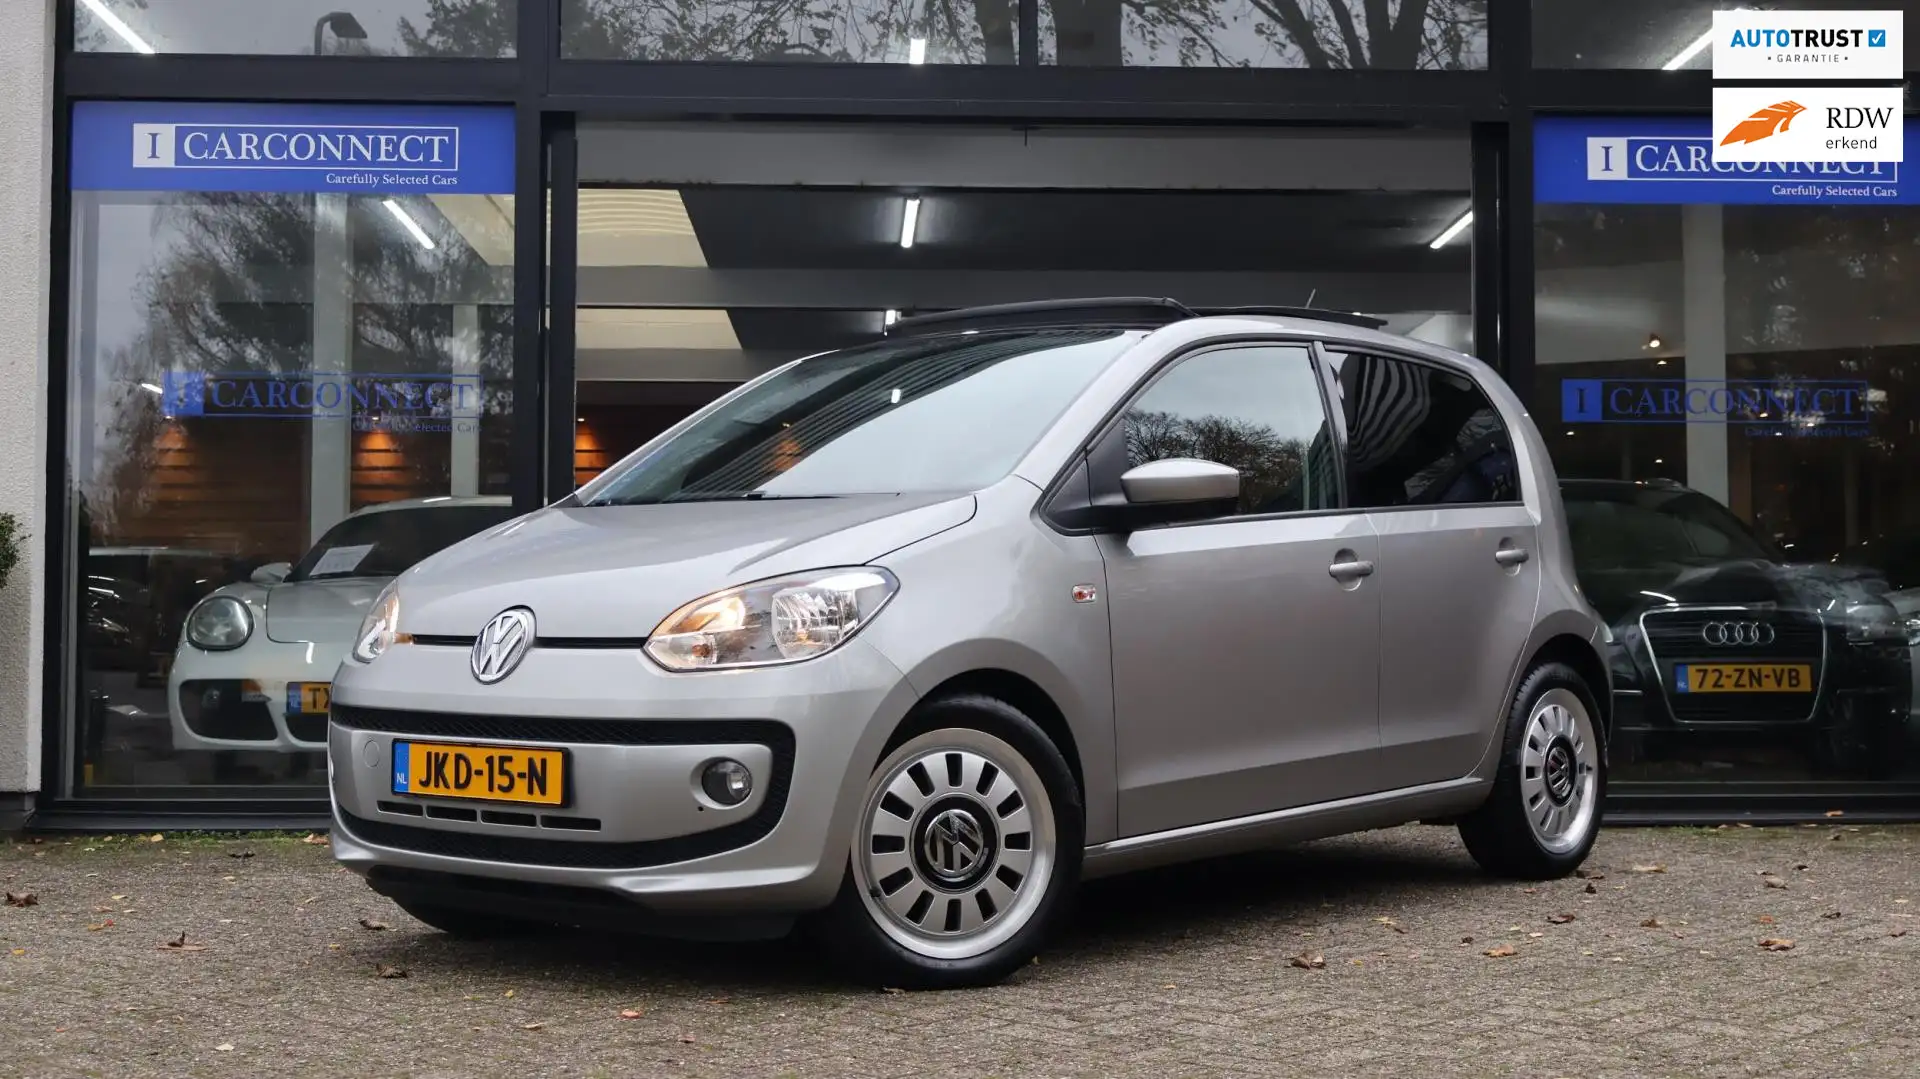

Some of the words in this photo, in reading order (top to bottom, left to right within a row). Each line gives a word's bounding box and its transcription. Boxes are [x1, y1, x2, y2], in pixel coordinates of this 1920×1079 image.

[184, 132, 449, 163] CARCONNECT
[326, 173, 379, 188] Carefully
[383, 174, 429, 185] Selected
[432, 175, 458, 185] Cars
[1772, 185, 1823, 199] Carefully
[1826, 186, 1870, 197] Selected
[1873, 187, 1898, 197] Cars
[212, 380, 474, 411] CARCONNECT
[1610, 388, 1860, 415] CARCONNECT
[1695, 667, 1801, 689] 72-ZN-VB
[396, 772, 408, 785] NL
[418, 750, 547, 796] JKD-15-N
